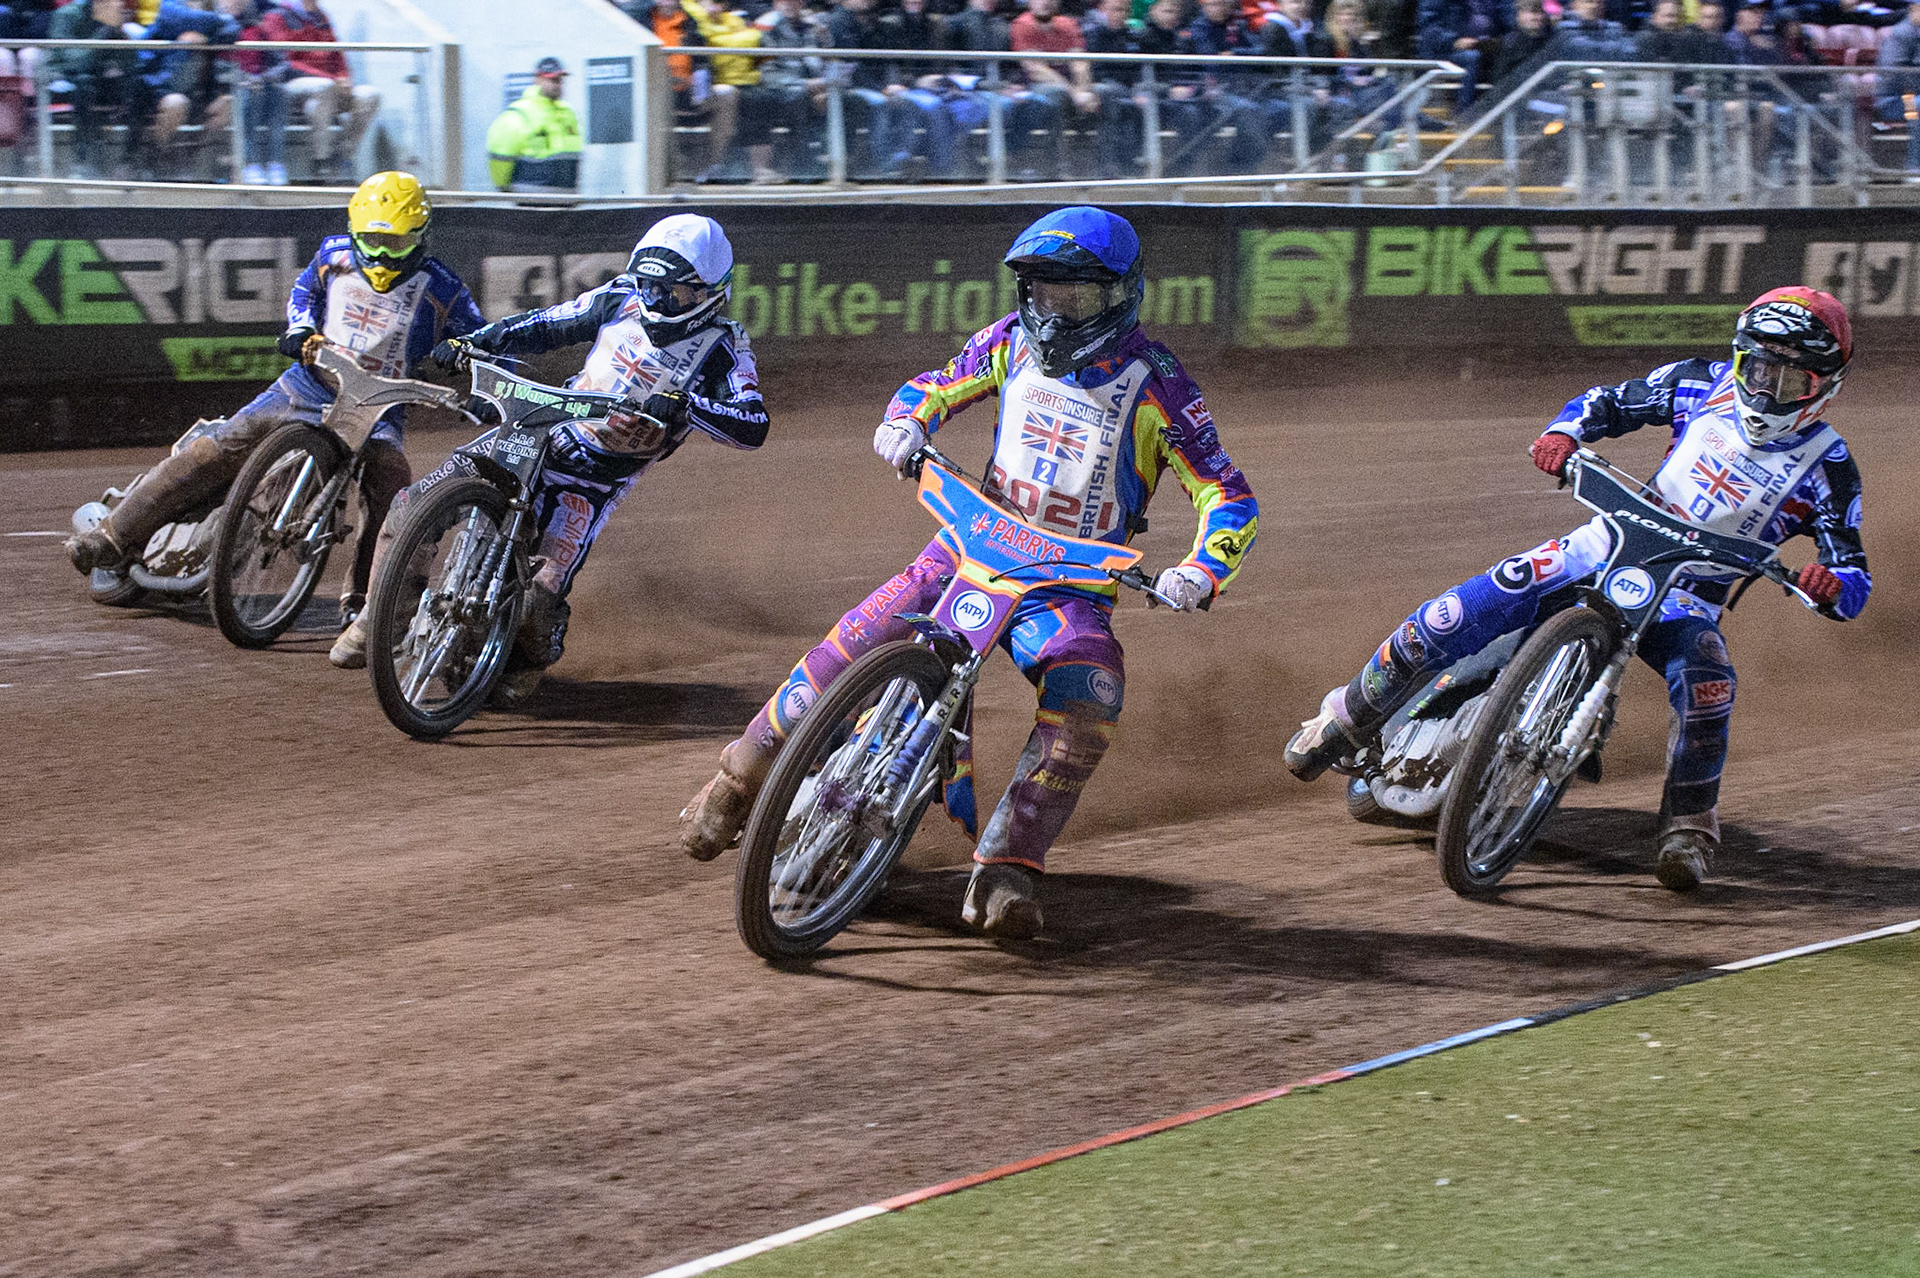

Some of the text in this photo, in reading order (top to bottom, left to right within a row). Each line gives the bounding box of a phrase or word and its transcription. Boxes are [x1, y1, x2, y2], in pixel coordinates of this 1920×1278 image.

[1363, 225, 1767, 297] BIKERIGHT
[670, 337, 704, 387] FINAL
[1025, 387, 1102, 424] SPORTS INSURE
[1101, 378, 1131, 448] FINAL
[1037, 461, 1052, 482] 2
[1704, 431, 1737, 463] SPOTS
[1079, 454, 1109, 539] BRITISH
[1761, 449, 1806, 506] FINAL
[989, 517, 1067, 566] PARRYS
[958, 602, 986, 620] ATPI
[1613, 578, 1646, 598] ATPI
